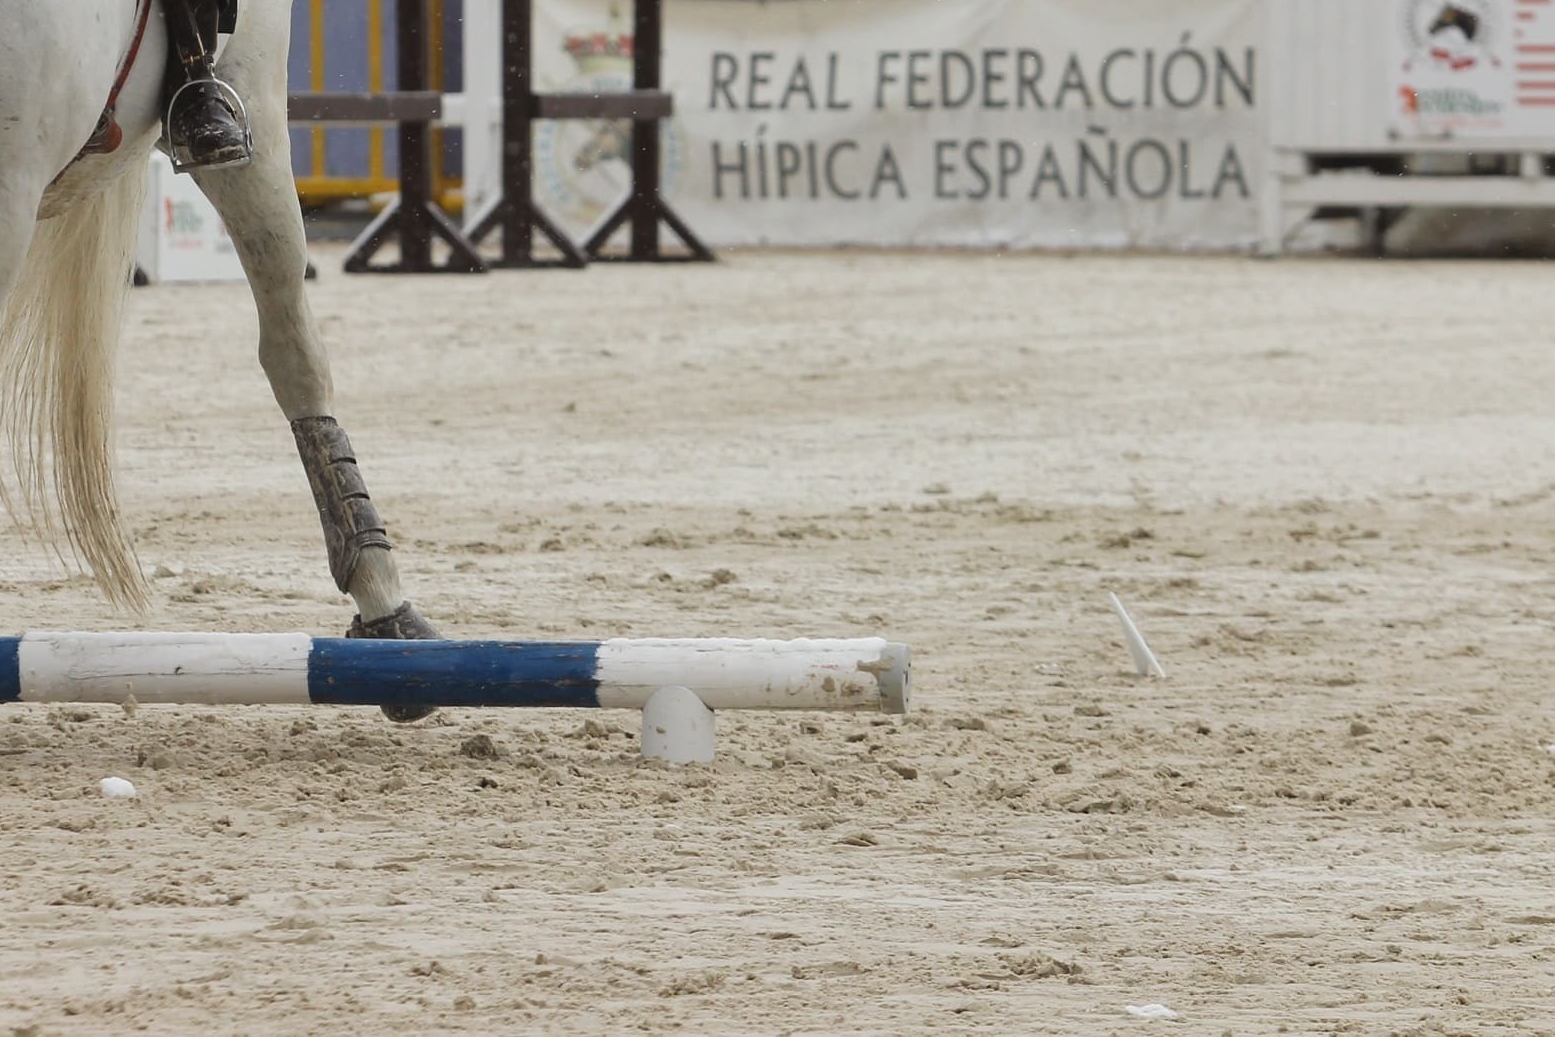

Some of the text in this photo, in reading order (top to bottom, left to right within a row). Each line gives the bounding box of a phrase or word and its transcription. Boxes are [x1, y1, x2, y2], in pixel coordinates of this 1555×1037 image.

[708, 32, 1256, 112] REAL FEDERACIÓN
[711, 125, 908, 202] HÍPICA
[934, 127, 1251, 202] ESPAÑOLA
